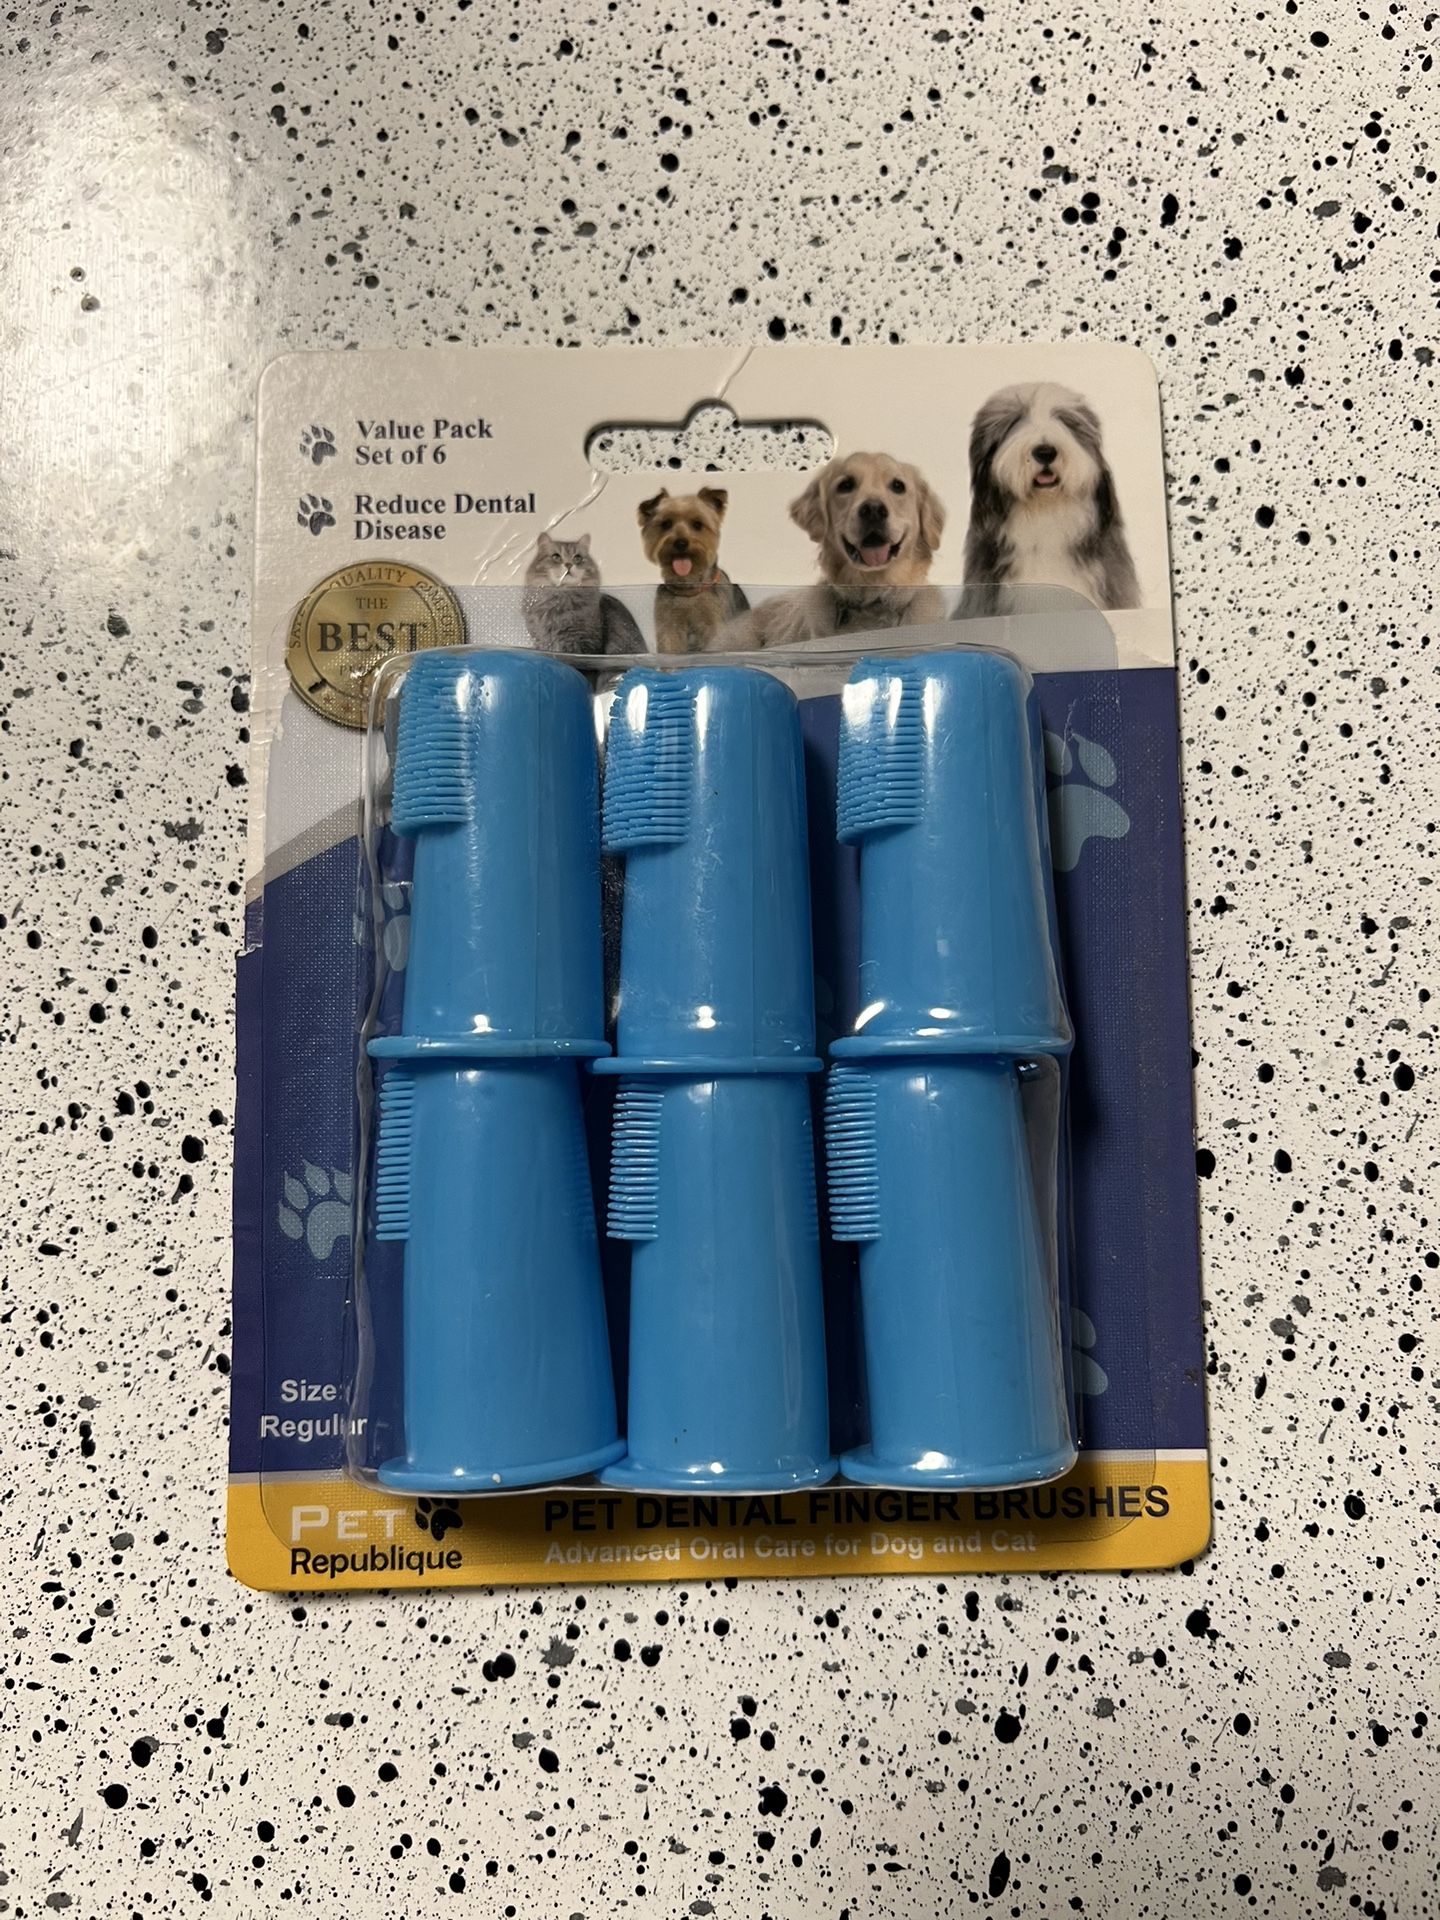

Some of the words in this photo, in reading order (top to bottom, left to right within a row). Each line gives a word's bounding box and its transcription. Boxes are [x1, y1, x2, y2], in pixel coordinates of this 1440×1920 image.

[357, 420, 425, 440] Value
[432, 419, 494, 439] Pack
[355, 445, 394, 466] Set
[401, 444, 428, 465] of
[433, 444, 447, 464] 6
[354, 495, 447, 515] Reduce
[453, 493, 536, 514] Dental
[354, 520, 447, 540] Disease
[355, 597, 388, 610] THE
[317, 622, 427, 652] BEST
[544, 1498, 622, 1532] PET
[635, 1490, 796, 1529] DENTAL
[808, 1487, 963, 1525] FINGER
[974, 1485, 1170, 1521] BRUSHES
[544, 1538, 681, 1564] Advanced
[689, 1535, 745, 1561] Oral
[754, 1534, 816, 1558] Care
[824, 1532, 860, 1556] for
[870, 1532, 924, 1560] Dog
[933, 1529, 982, 1554] and
[991, 1530, 1037, 1552] Cat
[290, 1544, 463, 1578] Republique
